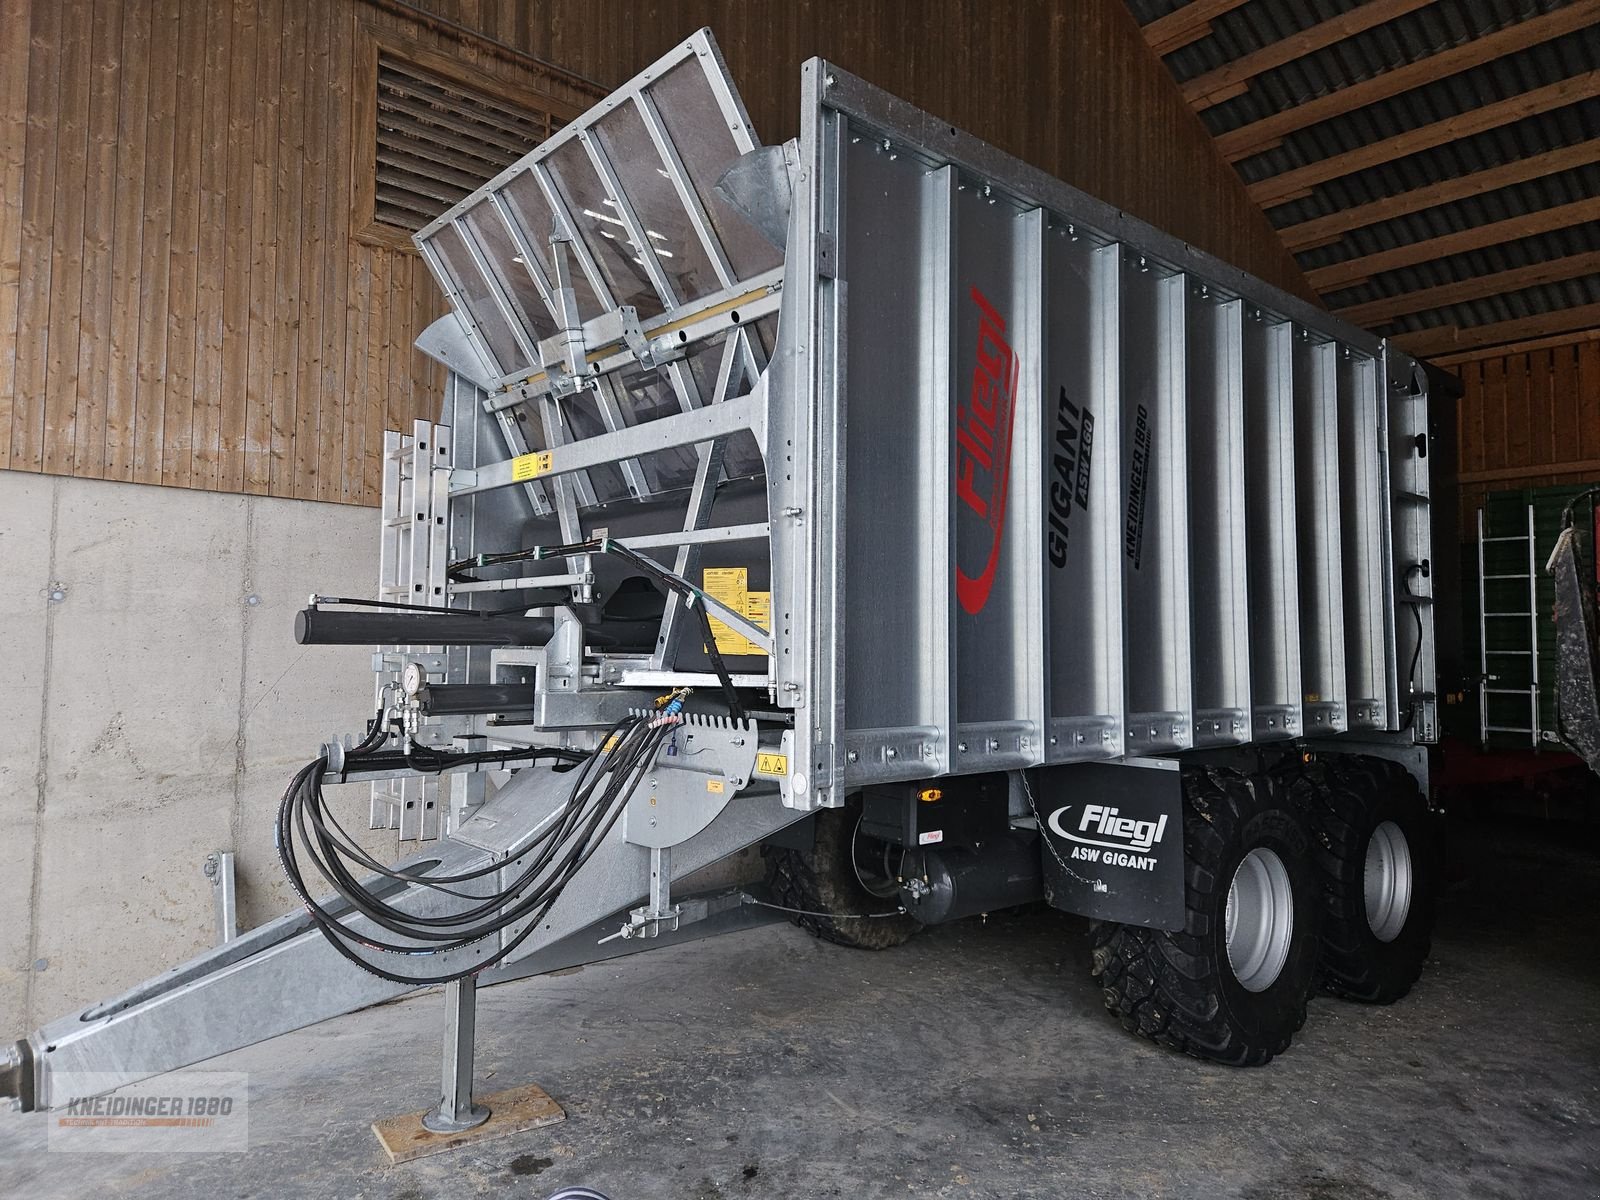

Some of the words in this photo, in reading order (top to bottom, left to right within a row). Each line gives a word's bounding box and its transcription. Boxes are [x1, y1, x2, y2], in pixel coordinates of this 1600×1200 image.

[956, 285, 1012, 518] Fliegl
[1078, 418, 1093, 457] 160
[1134, 404, 1149, 449] 1880
[1048, 385, 1081, 569] GIGANT
[1077, 458, 1090, 502] ASW
[1126, 450, 1145, 560] KNEIDINGER
[1078, 804, 1168, 848] Fliegl
[1071, 846, 1100, 862] ASW
[1102, 851, 1158, 871] GIGANT
